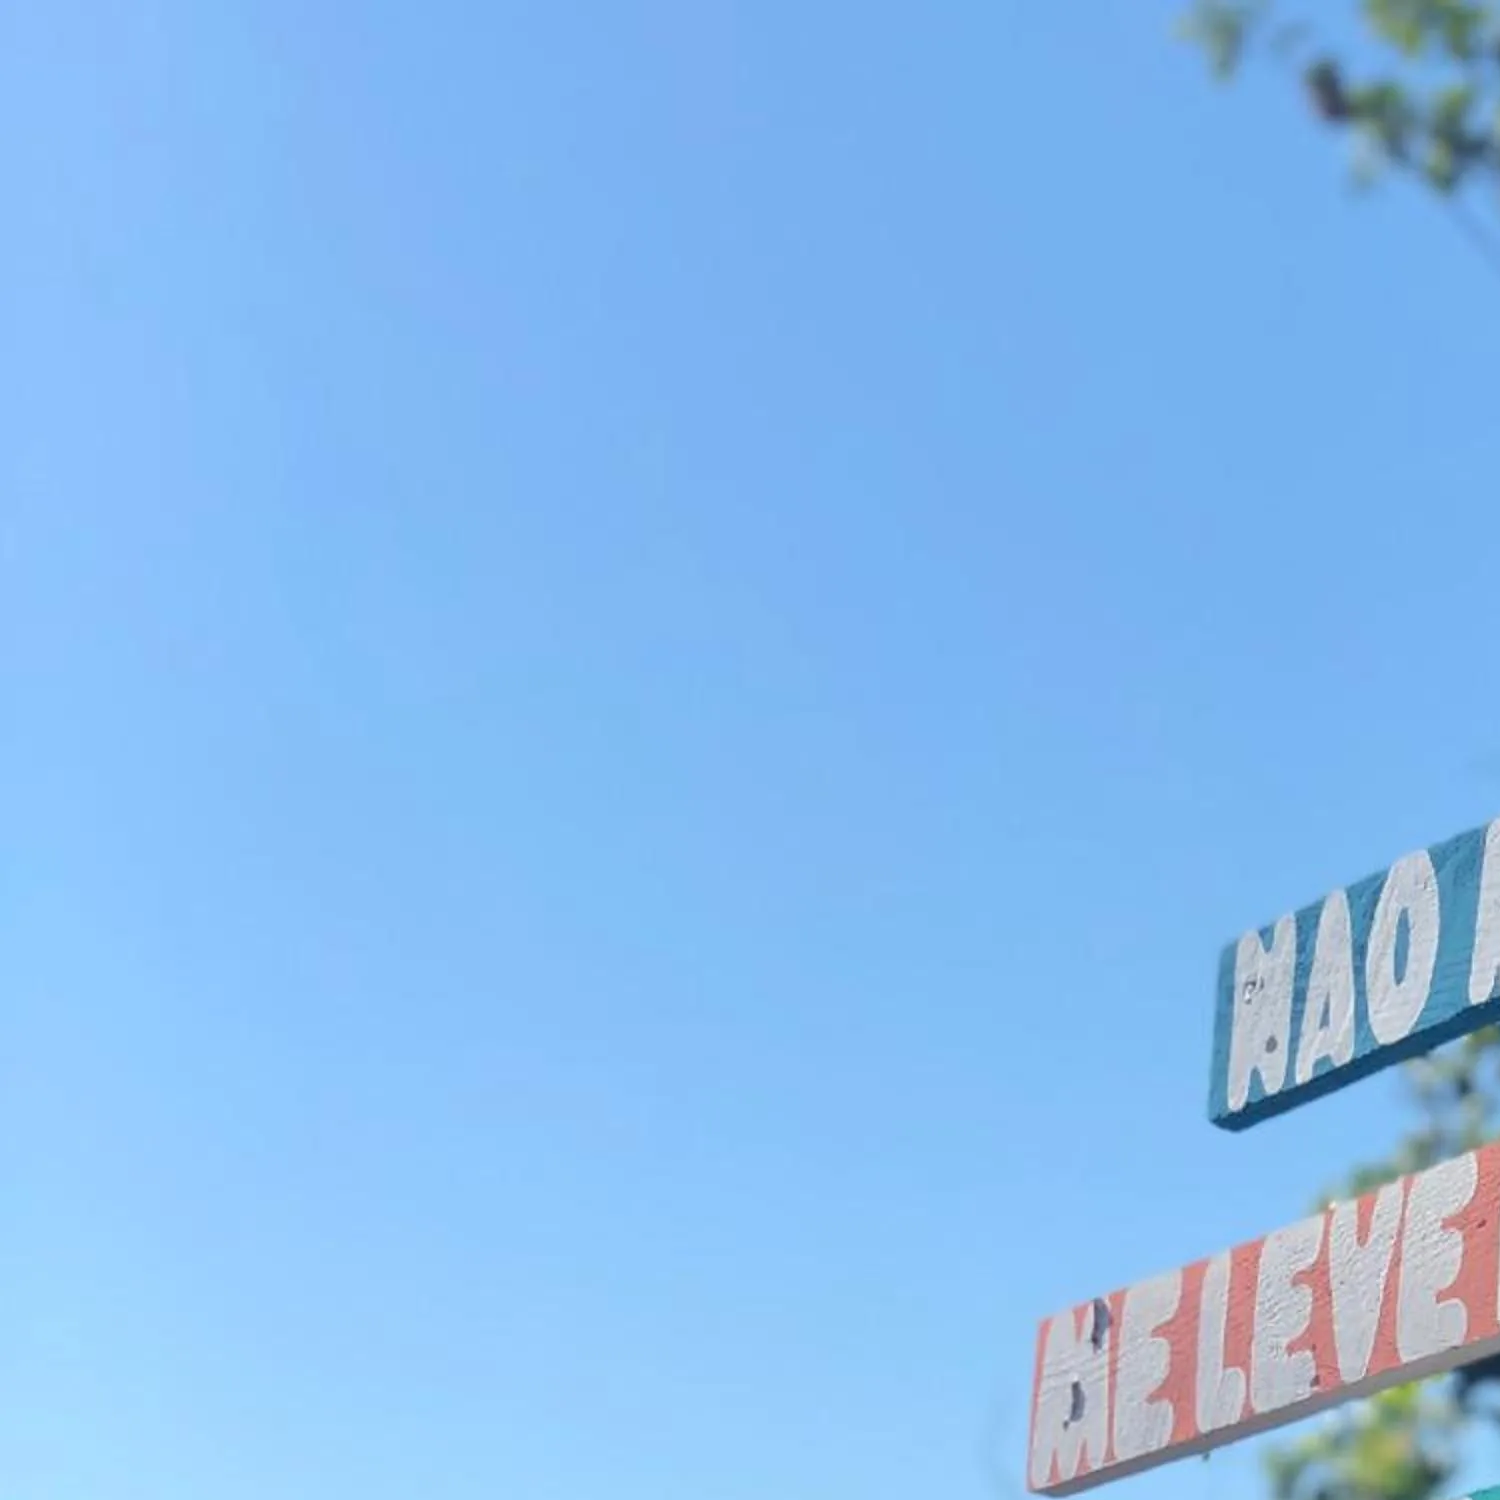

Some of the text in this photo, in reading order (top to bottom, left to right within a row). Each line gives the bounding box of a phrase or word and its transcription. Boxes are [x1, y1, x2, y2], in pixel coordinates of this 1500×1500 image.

[1226, 850, 1440, 1111] NAO
[1032, 1267, 1182, 1486] ME
[1197, 1151, 1479, 1433] LEVE
